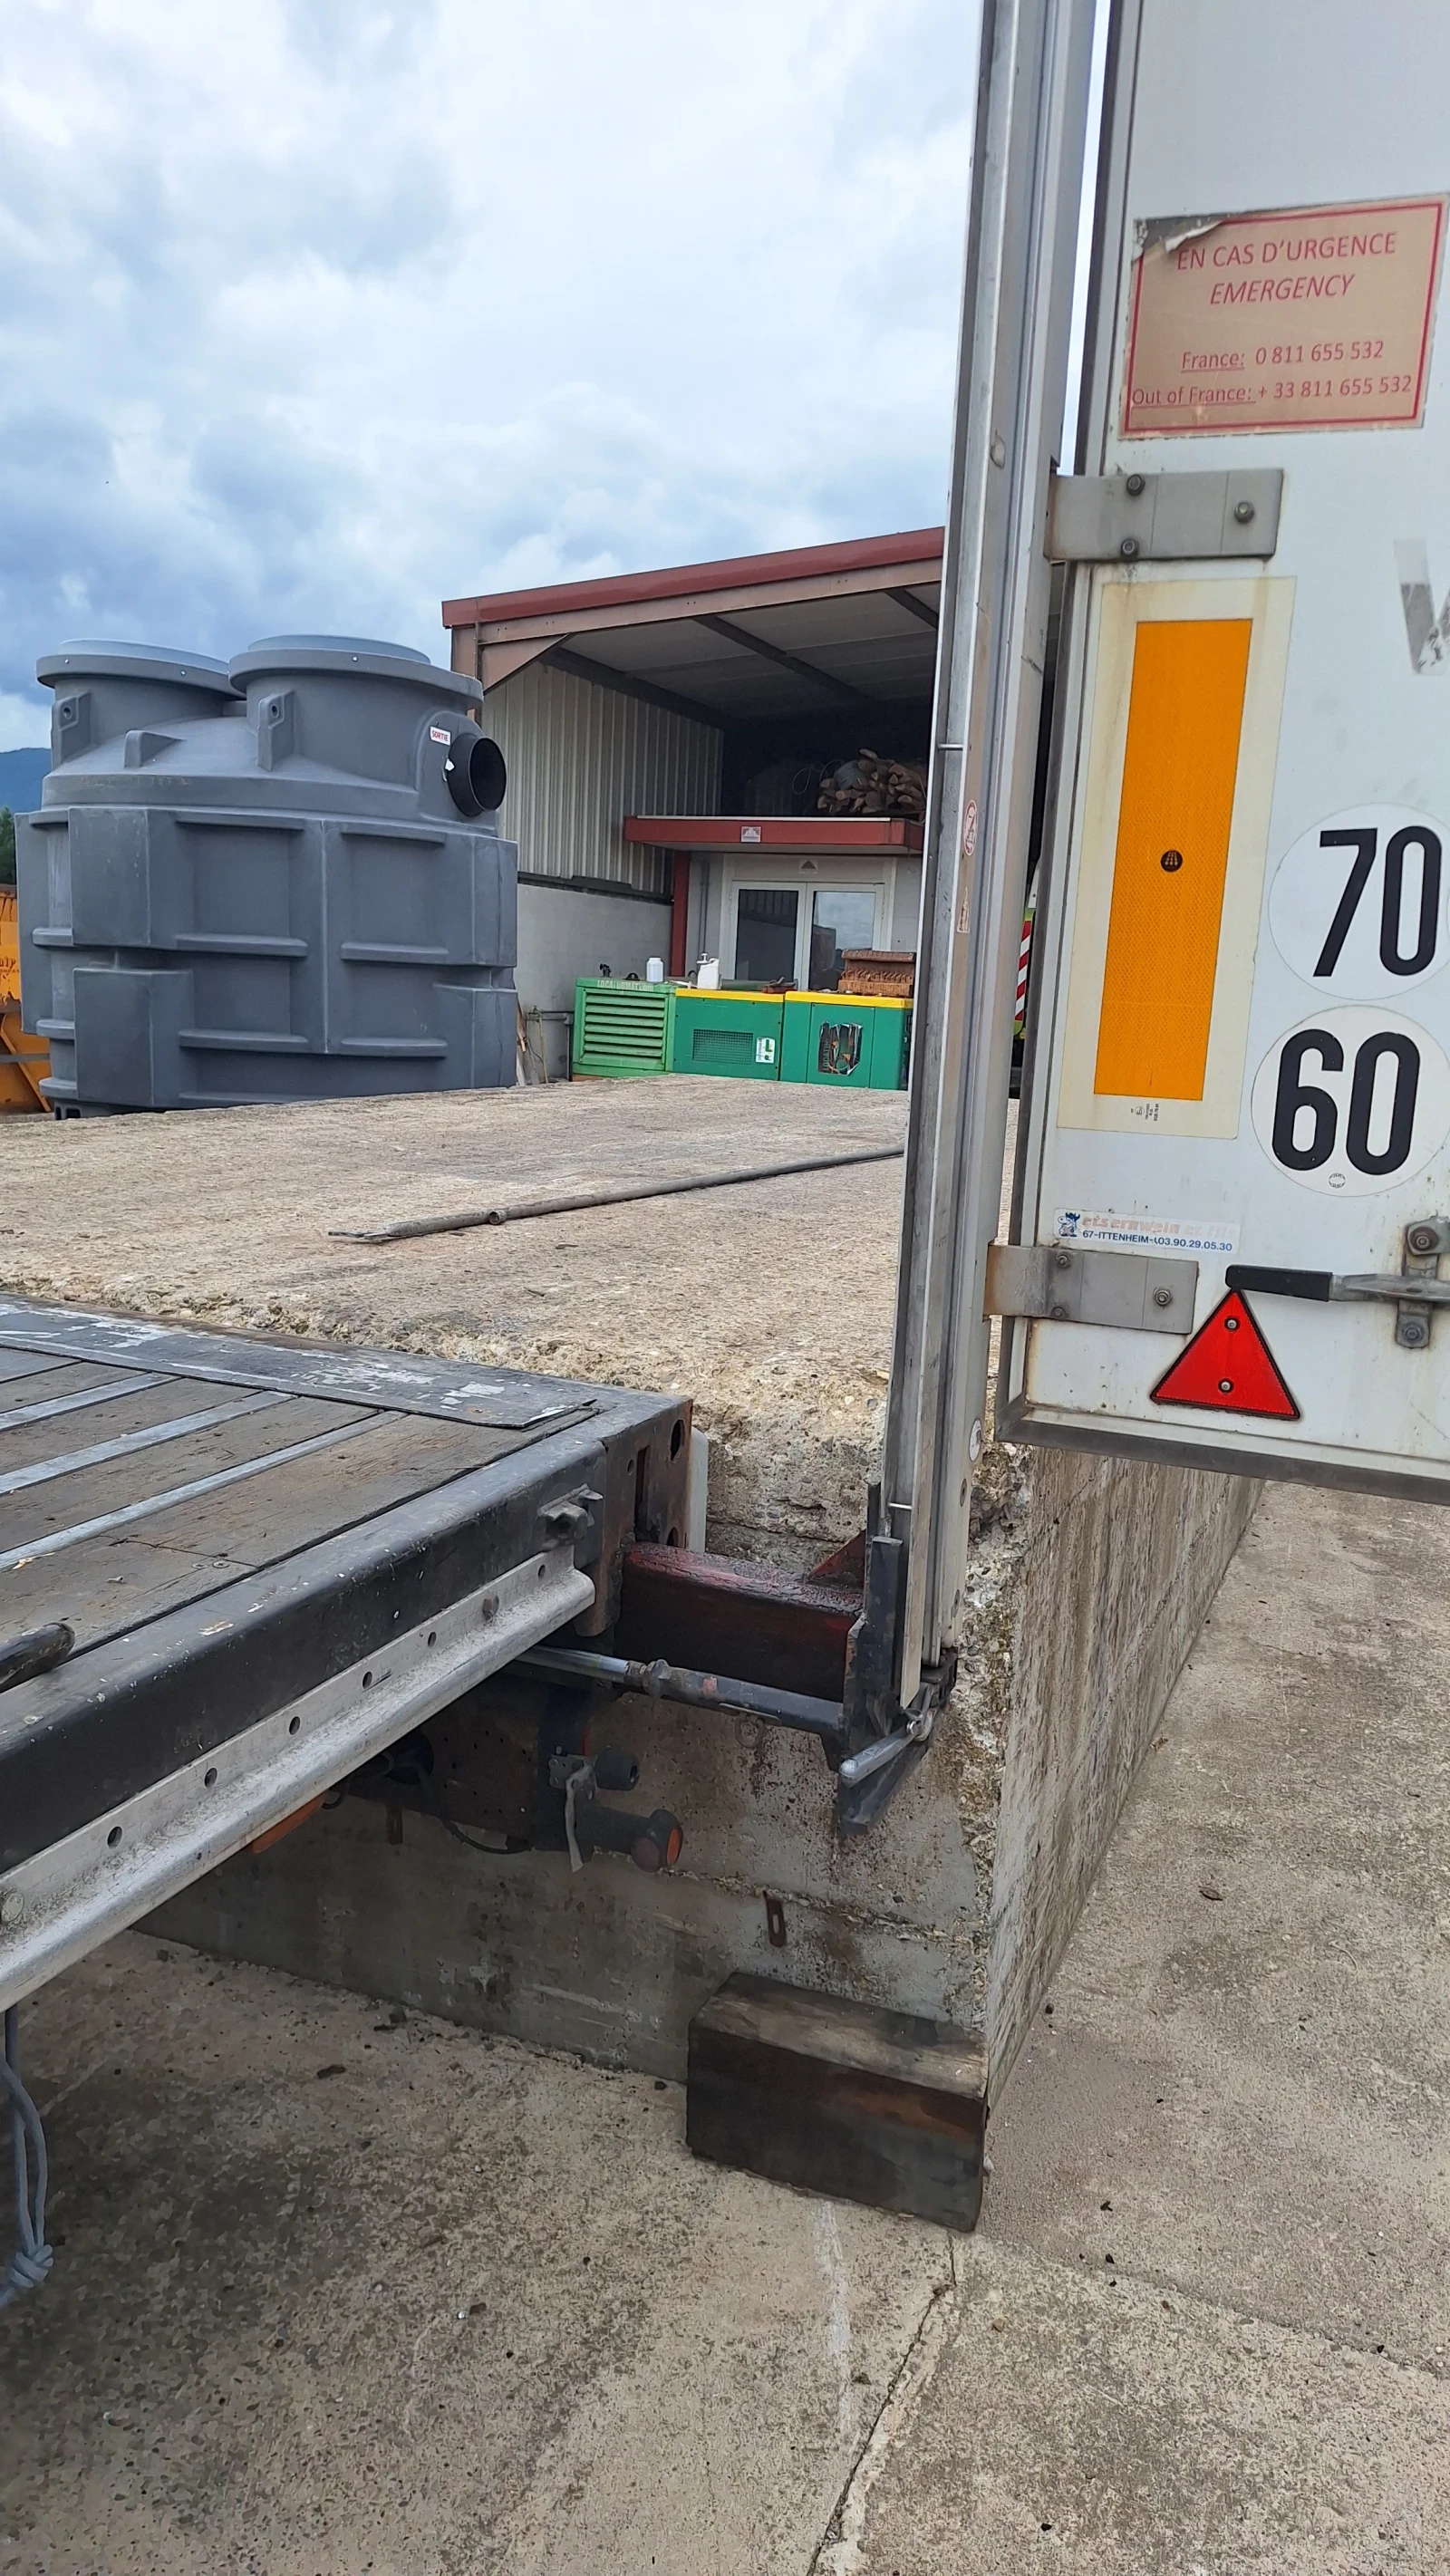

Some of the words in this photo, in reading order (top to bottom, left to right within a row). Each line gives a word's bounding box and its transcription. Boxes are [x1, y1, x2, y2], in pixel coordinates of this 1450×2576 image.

[1178, 247, 1204, 271] EN
[1213, 243, 1253, 267] CAS
[1210, 274, 1356, 305] EMERGENCY
[1181, 351, 1245, 371] France:
[1256, 347, 1267, 364] 0
[1271, 345, 1303, 363] 811
[1311, 343, 1344, 362] 655
[1350, 341, 1384, 360] 532
[1133, 387, 1162, 405] Out
[1167, 385, 1184, 404] of
[1189, 385, 1252, 404] France:
[1273, 381, 1294, 400] 33
[1300, 380, 1332, 398] 811
[1339, 378, 1373, 396] 655
[1379, 376, 1412, 394] 532
[431, 730, 449, 741] SORTIE
[1312, 825, 1443, 977] 70
[1271, 1029, 1421, 1176] 60
